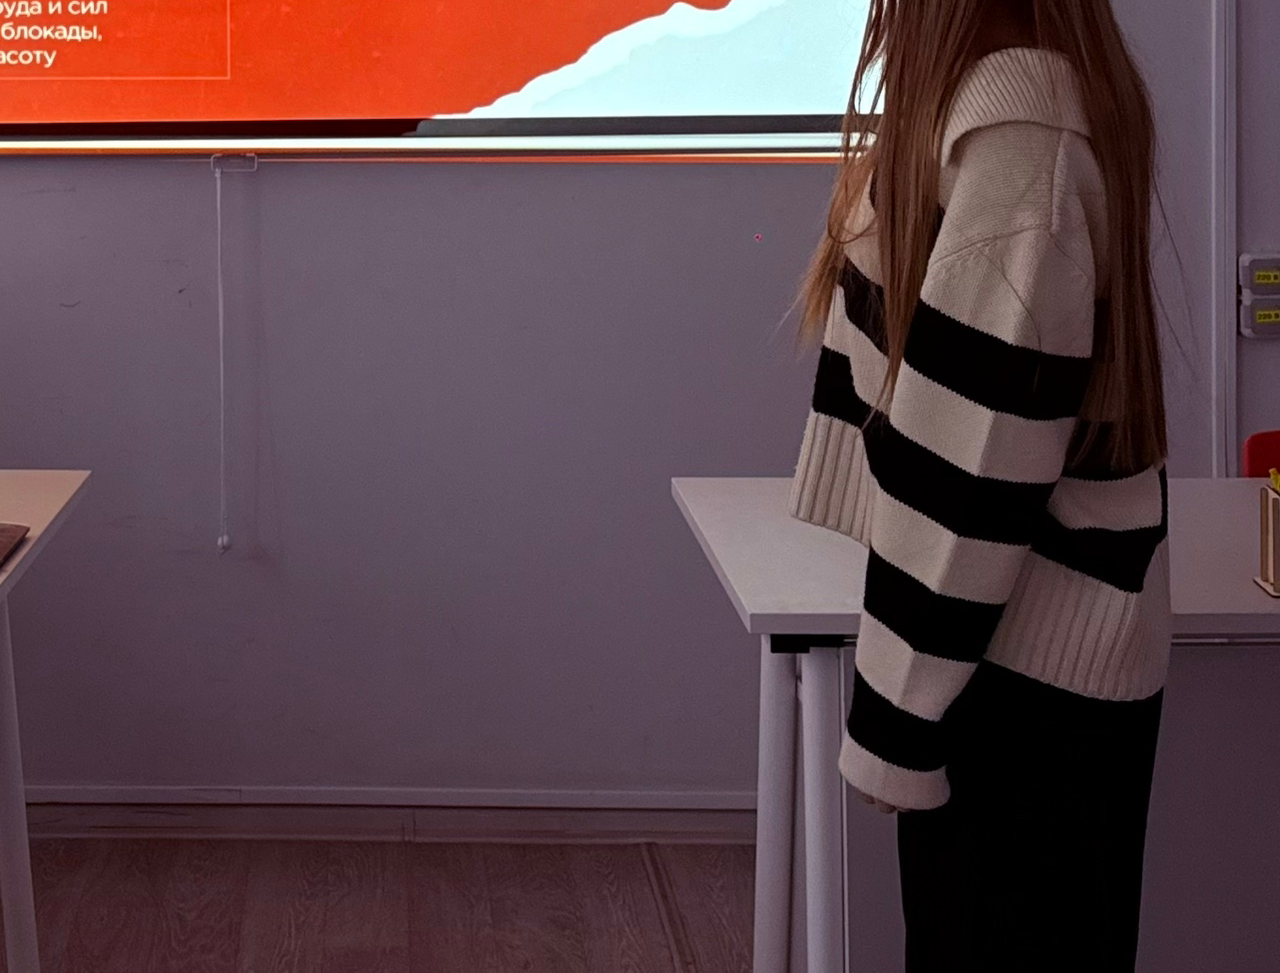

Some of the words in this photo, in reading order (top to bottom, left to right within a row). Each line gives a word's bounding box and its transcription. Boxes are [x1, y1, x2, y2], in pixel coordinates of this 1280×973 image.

[48, 0, 62, 15] и
[67, 0, 108, 15] сил
[0, 21, 103, 42] блокады,
